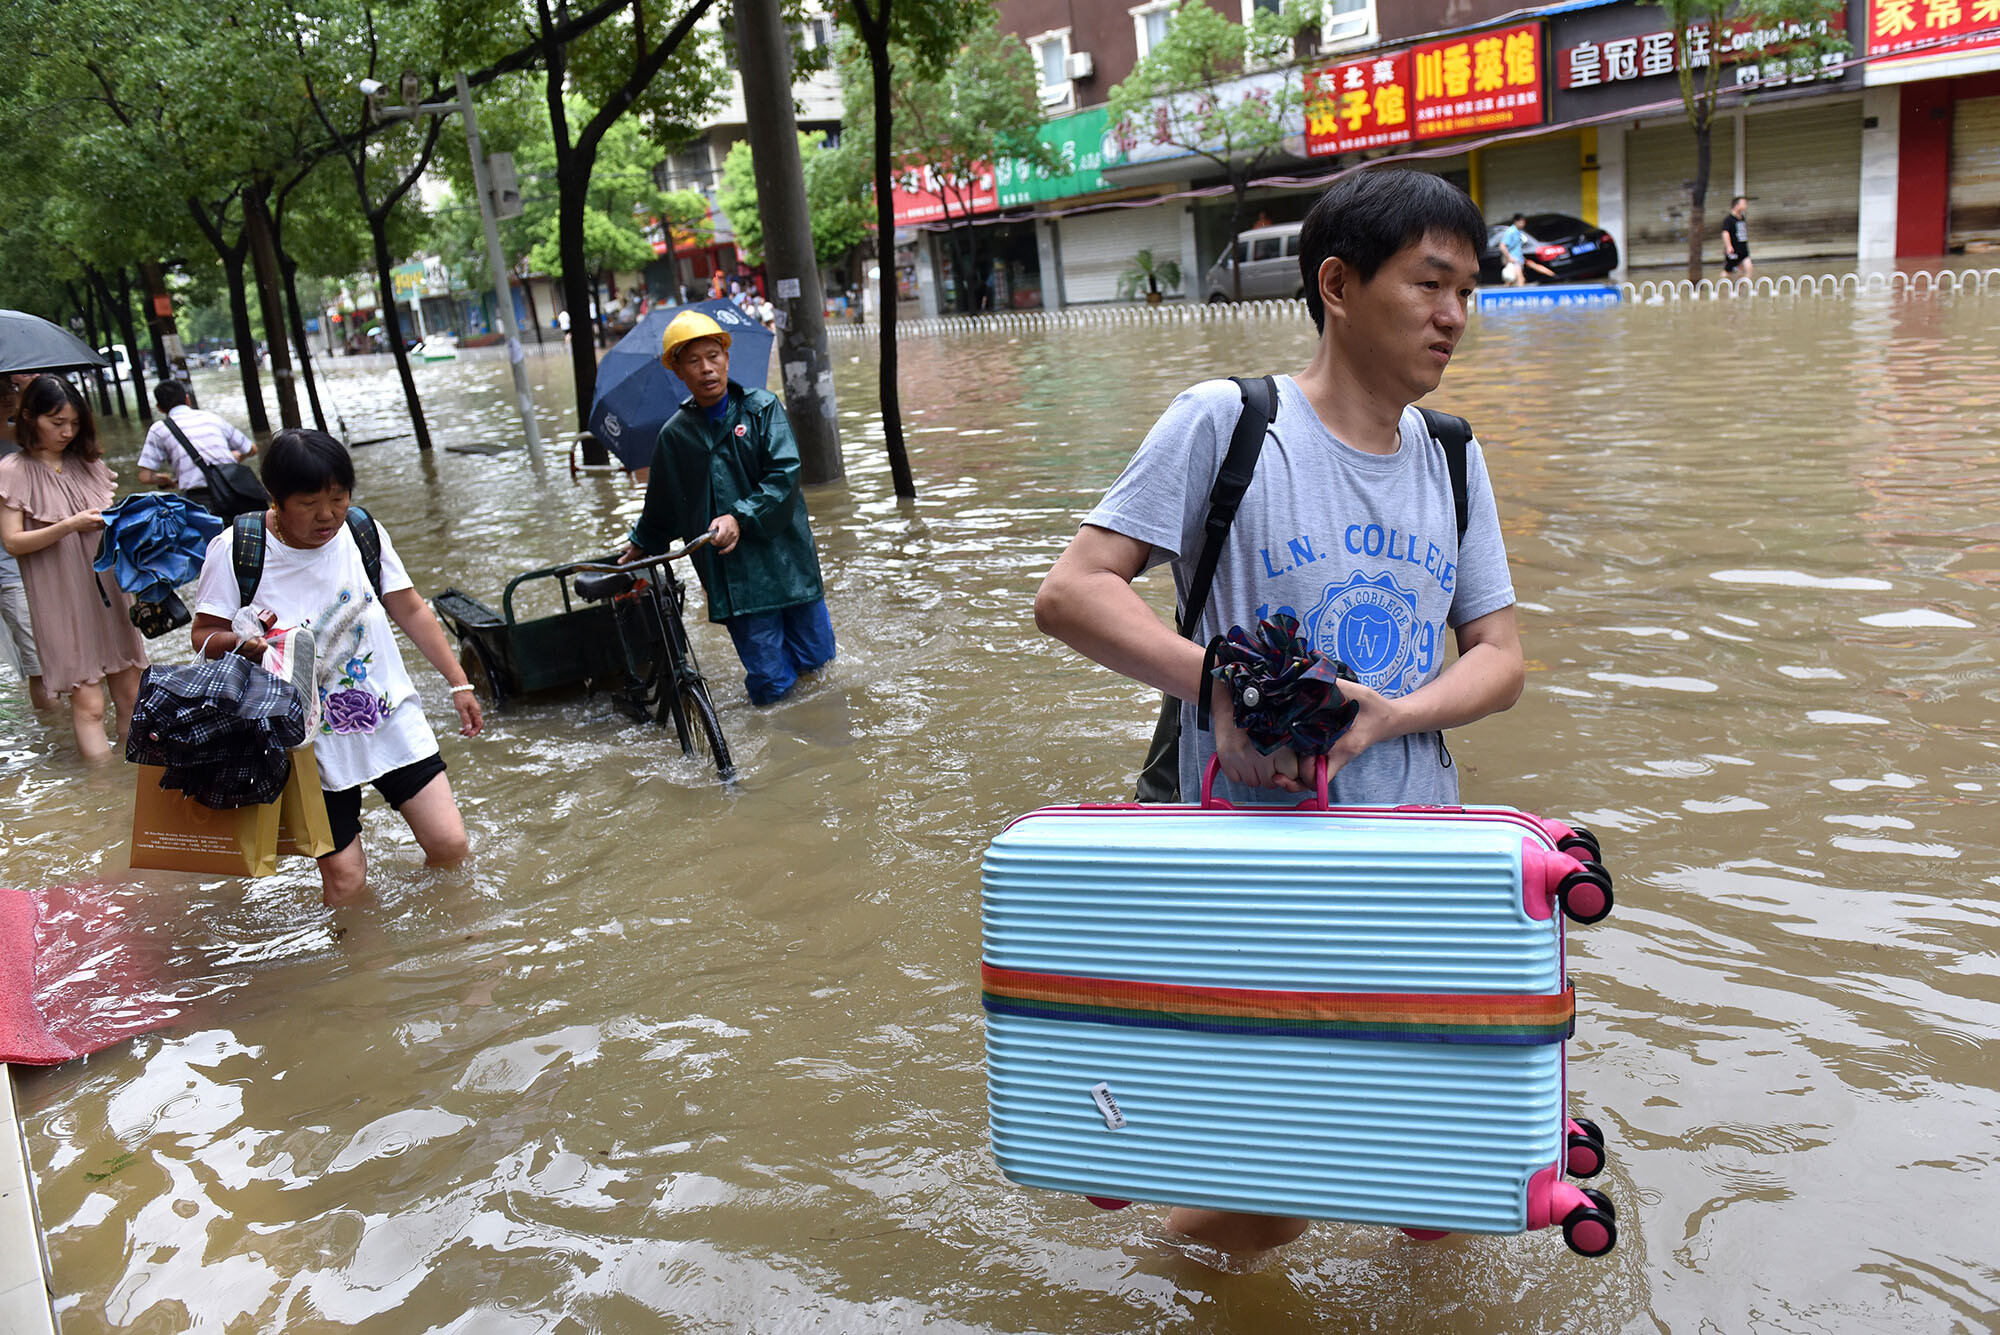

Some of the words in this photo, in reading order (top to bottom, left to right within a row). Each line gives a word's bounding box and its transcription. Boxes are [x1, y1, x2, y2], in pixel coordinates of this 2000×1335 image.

[1415, 31, 1537, 102] 川香菜馆
[1309, 84, 1407, 136] 饺子馆
[1260, 536, 1326, 578] L.N.
